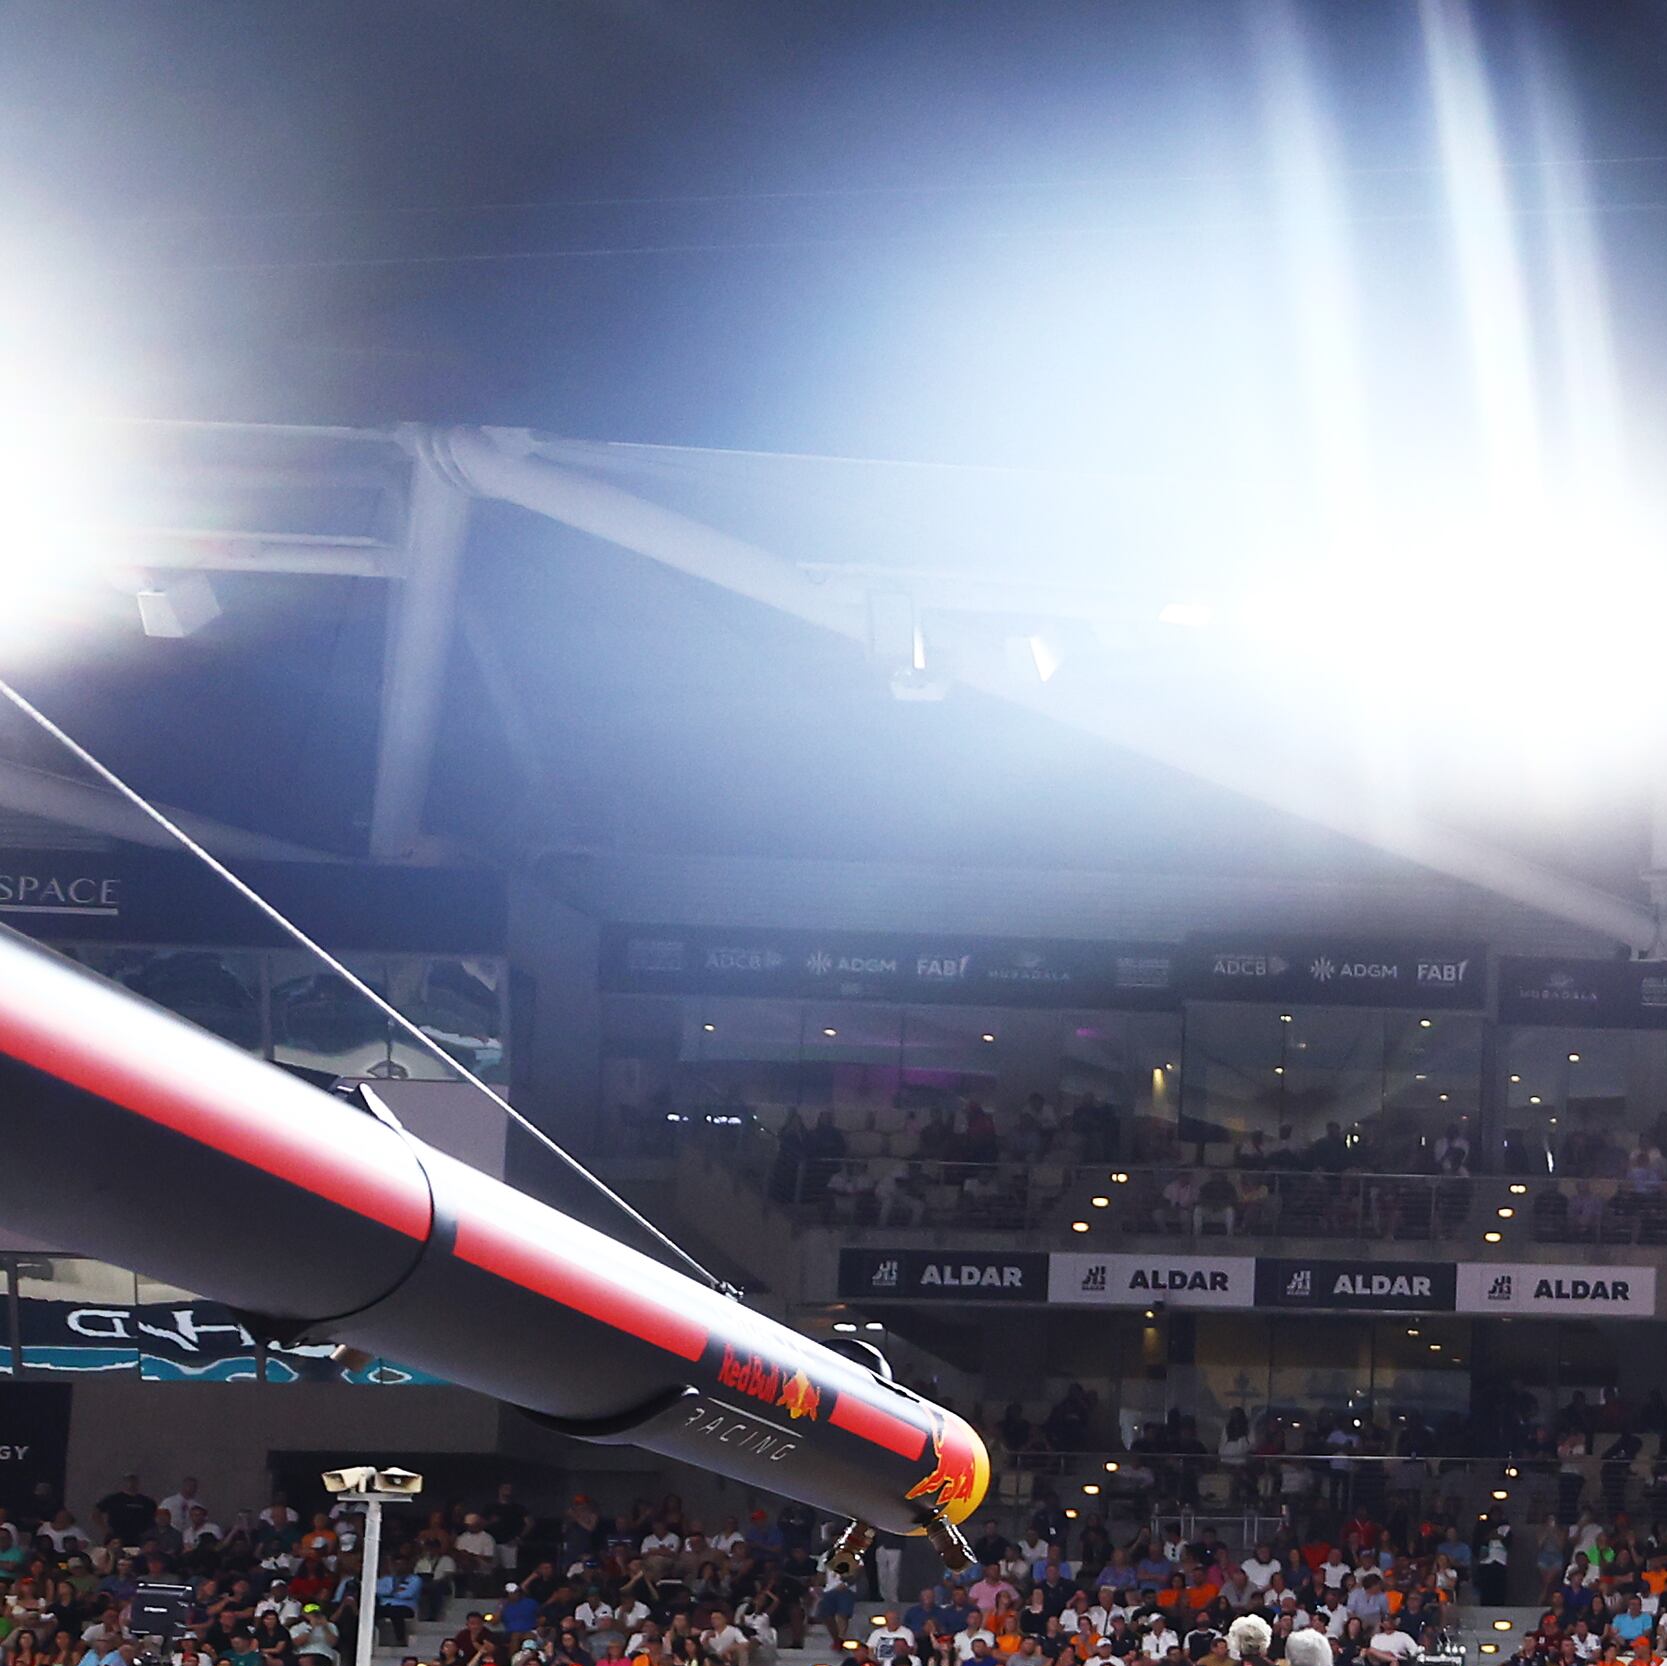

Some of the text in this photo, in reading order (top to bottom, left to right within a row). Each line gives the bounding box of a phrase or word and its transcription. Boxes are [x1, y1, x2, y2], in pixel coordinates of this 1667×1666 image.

[837, 959, 897, 973] ADGM
[917, 959, 961, 977] FAB
[1214, 959, 1267, 975] ADCB
[1340, 963, 1398, 978] ADGM
[1417, 963, 1457, 982] FAB
[920, 1265, 1023, 1287] ALDAR
[1128, 1270, 1229, 1291] ALDAR
[1333, 1274, 1432, 1297] ALDAR
[1534, 1279, 1631, 1301] ALDAR
[685, 1408, 797, 1461] RACING
